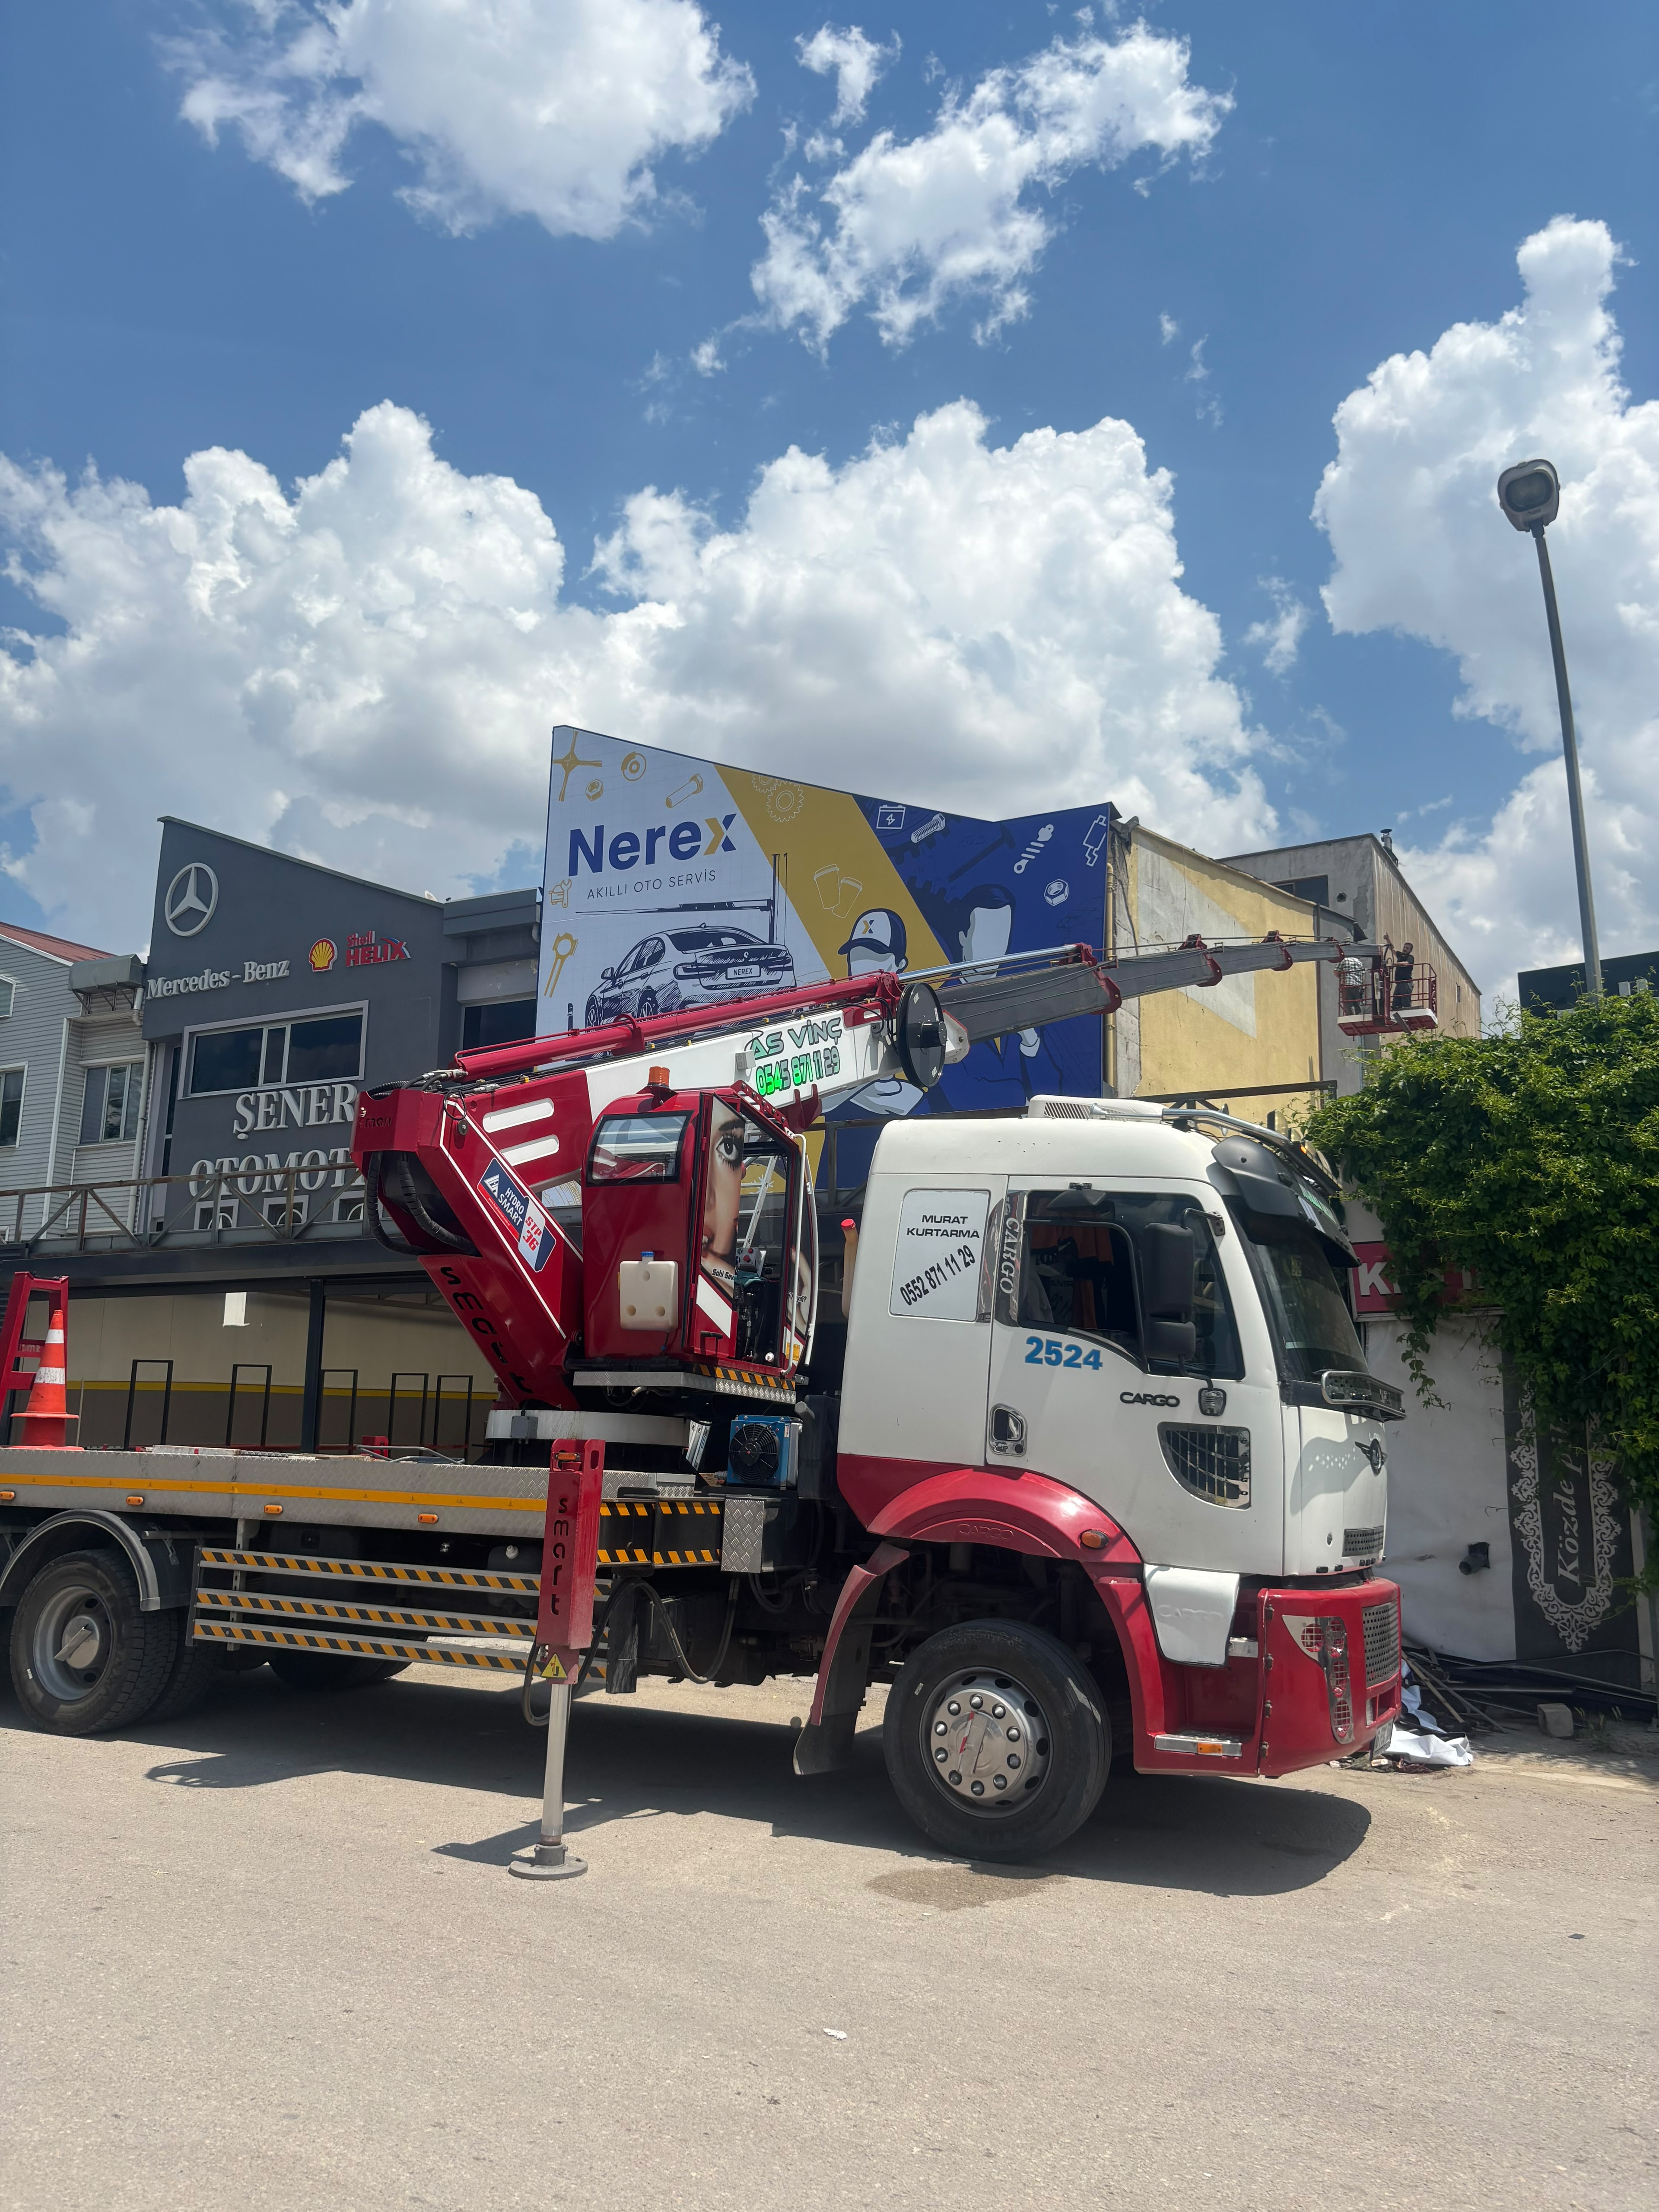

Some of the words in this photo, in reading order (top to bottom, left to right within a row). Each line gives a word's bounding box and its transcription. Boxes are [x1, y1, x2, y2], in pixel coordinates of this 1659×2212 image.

[568, 813, 737, 877] Nerex
[587, 884, 627, 899] AKILLI
[634, 879, 662, 893] OTO
[669, 869, 716, 887] SERVİS
[346, 931, 375, 947] Shell
[346, 937, 411, 967] HELIX
[733, 968, 753, 976] NEREX
[750, 1031, 785, 1061] AS
[787, 1017, 842, 1049] VİNÇ
[756, 1059, 791, 1097] 0545
[791, 1053, 814, 1086] 871
[813, 1050, 823, 1080] 11
[823, 1046, 840, 1077] 29
[233, 1083, 358, 1140] ŞENER
[189, 1147, 365, 1199] OTOMOT
[498, 1194, 522, 1226] SMART
[505, 1187, 524, 1214] HYDRO
[525, 1216, 542, 1236] STP
[906, 1227, 980, 1238] KURTARMA
[922, 1215, 968, 1224] MURAT
[522, 1230, 539, 1251] 36
[999, 1217, 1020, 1294] CARGO
[900, 1276, 929, 1306] 0552
[925, 1262, 948, 1289] 871
[944, 1253, 962, 1276] 11
[957, 1245, 976, 1268] 29
[1025, 1336, 1103, 1370] 2524
[1119, 1392, 1180, 1408] CARGO
[1553, 1479, 1582, 1586] Közde
[551, 1498, 569, 1615] smart
